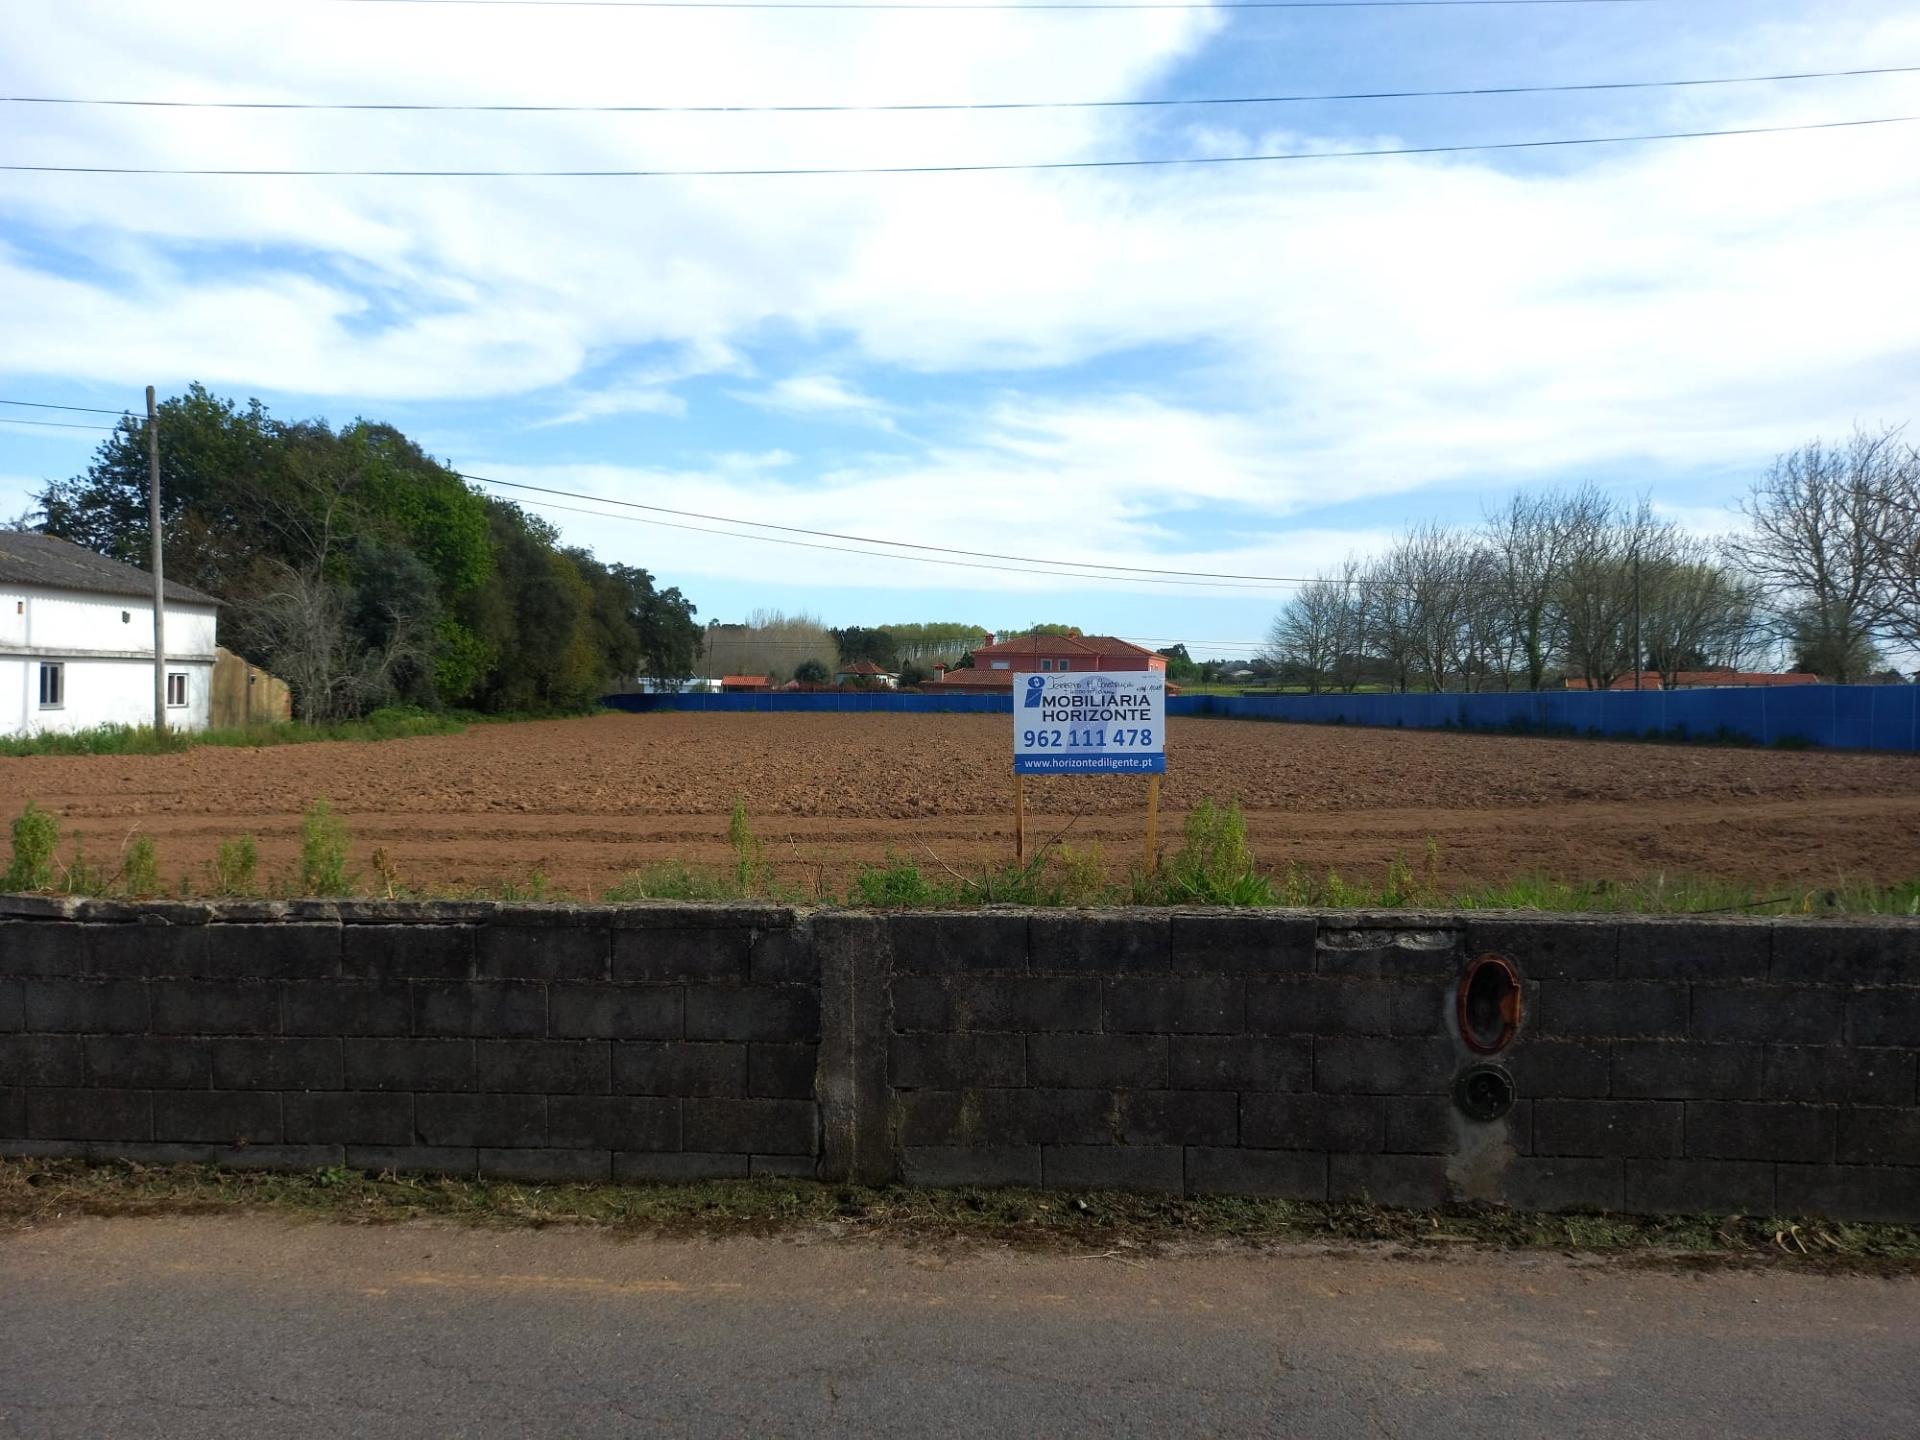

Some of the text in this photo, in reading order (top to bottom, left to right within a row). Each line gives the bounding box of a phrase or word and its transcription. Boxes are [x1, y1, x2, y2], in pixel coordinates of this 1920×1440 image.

[1042, 709, 1151, 722] HORIZONTE
[1023, 729, 1152, 748] 962 111 478
[1024, 758, 1153, 769] www.horizontediligente.pt
